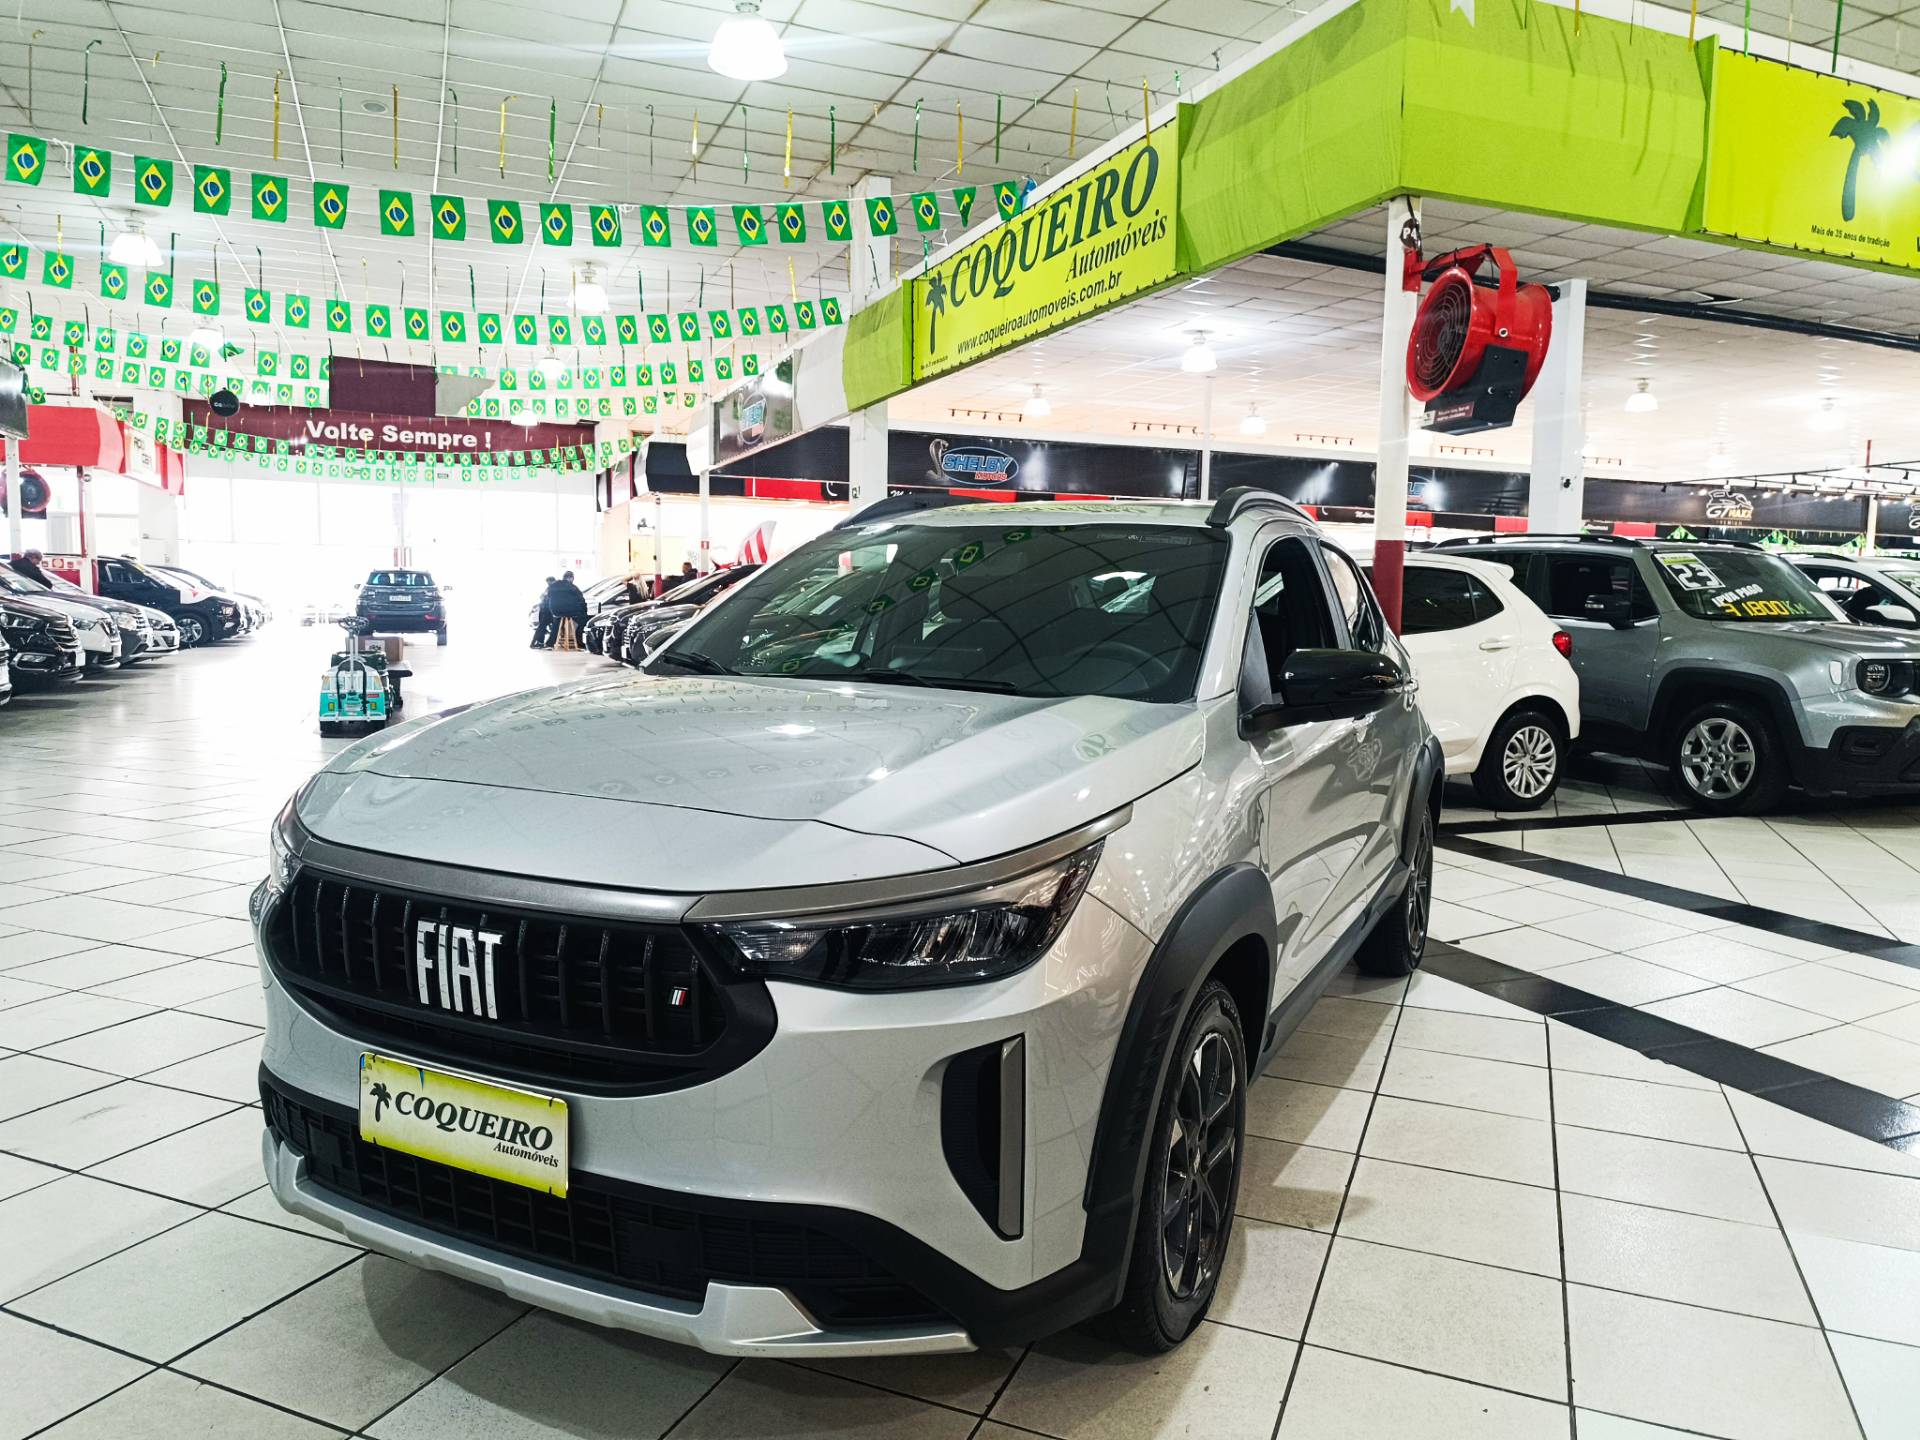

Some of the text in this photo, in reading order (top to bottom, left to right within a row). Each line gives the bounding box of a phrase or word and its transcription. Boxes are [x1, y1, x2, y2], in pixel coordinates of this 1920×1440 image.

[950, 145, 1159, 308] COQUEIRO
[1064, 208, 1168, 283] Automóveis
[1811, 225, 1825, 235] Mais
[1826, 228, 1834, 237] de
[1844, 232, 1857, 242] anos
[1859, 234, 1866, 243] de
[1867, 235, 1890, 247] tradição
[957, 269, 1123, 354] www.coqueiroautomoveis.com.br
[306, 420, 491, 449] Volte Sempre !
[942, 453, 1013, 473] SHELBY
[1711, 591, 1740, 607] IPVA
[416, 919, 503, 1020] FIAT
[395, 1091, 553, 1151] COQUEIRO
[493, 1141, 560, 1168] Automóveis
